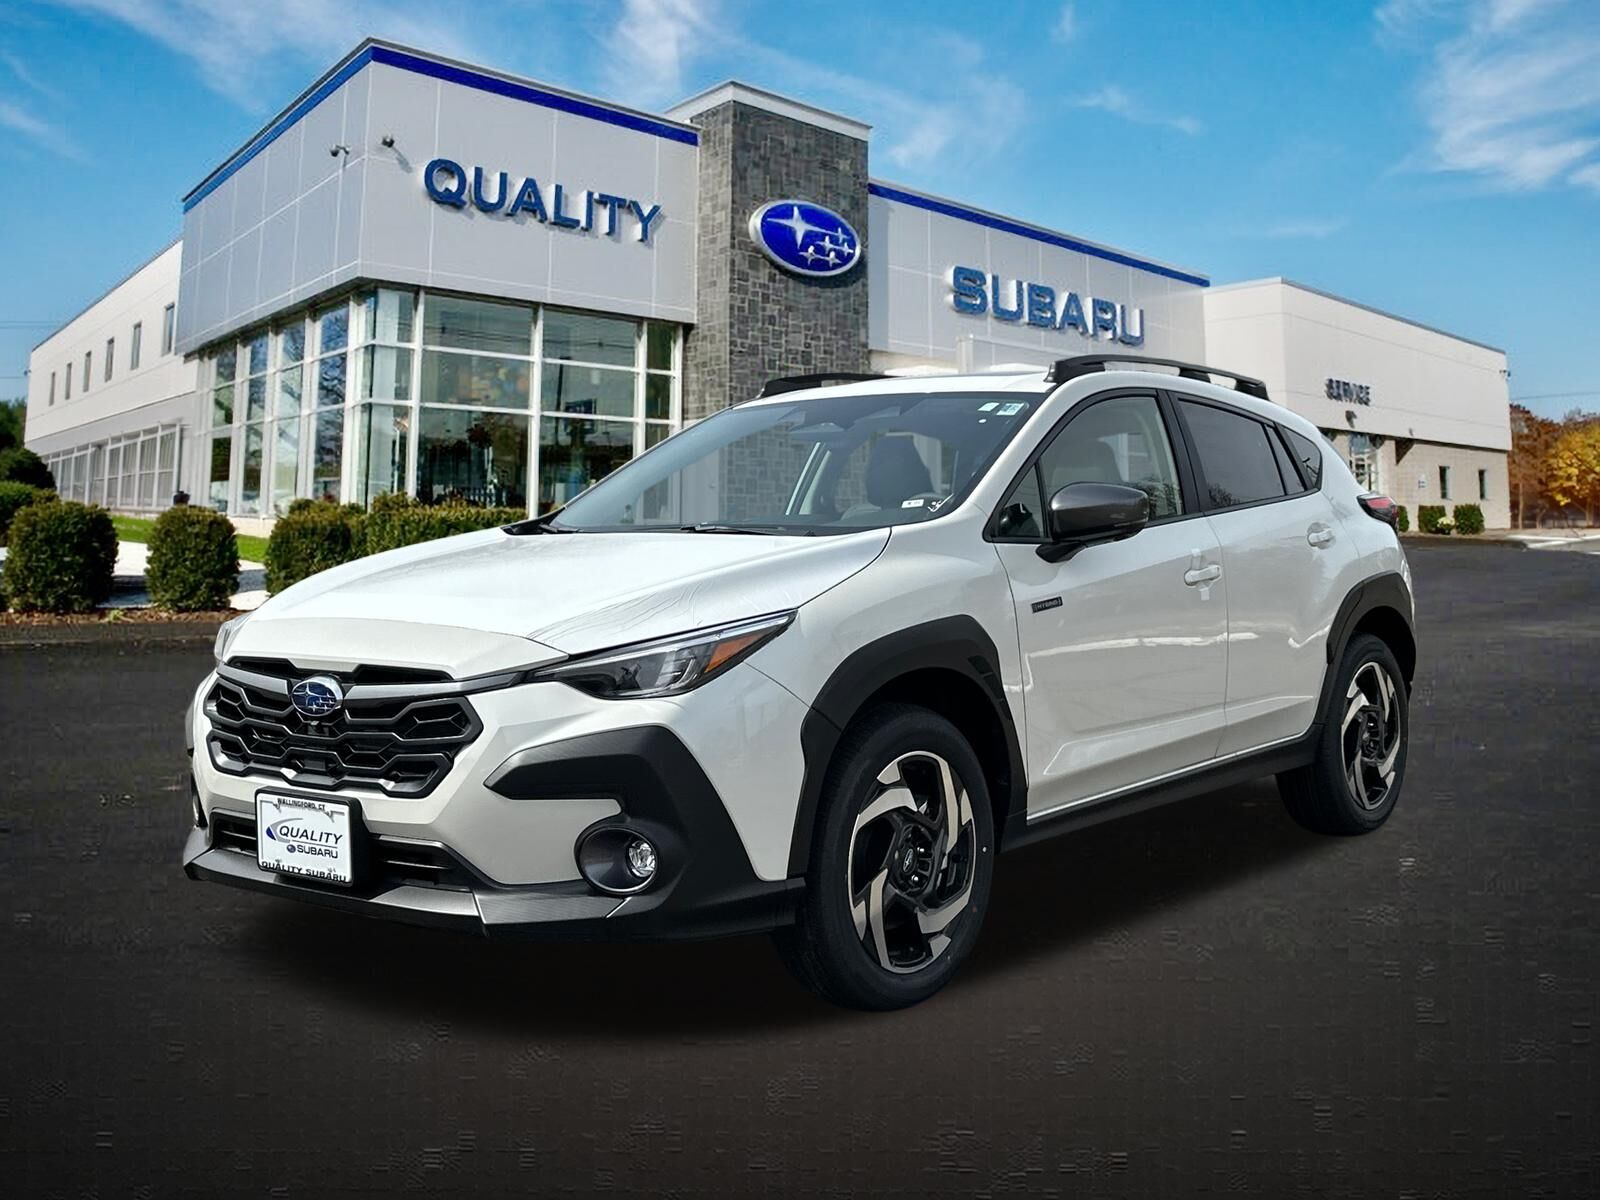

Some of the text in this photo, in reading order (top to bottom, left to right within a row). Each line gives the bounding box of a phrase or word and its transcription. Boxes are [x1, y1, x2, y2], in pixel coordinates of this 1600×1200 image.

[424, 158, 661, 243] QUALITY
[950, 265, 1145, 346] SUBARU
[1325, 378, 1371, 407] SERVICE
[319, 803, 325, 811] CT
[279, 825, 343, 844] QUALITY
[297, 845, 338, 859] SUBARU
[262, 861, 347, 882] QUALITY SUBARU
